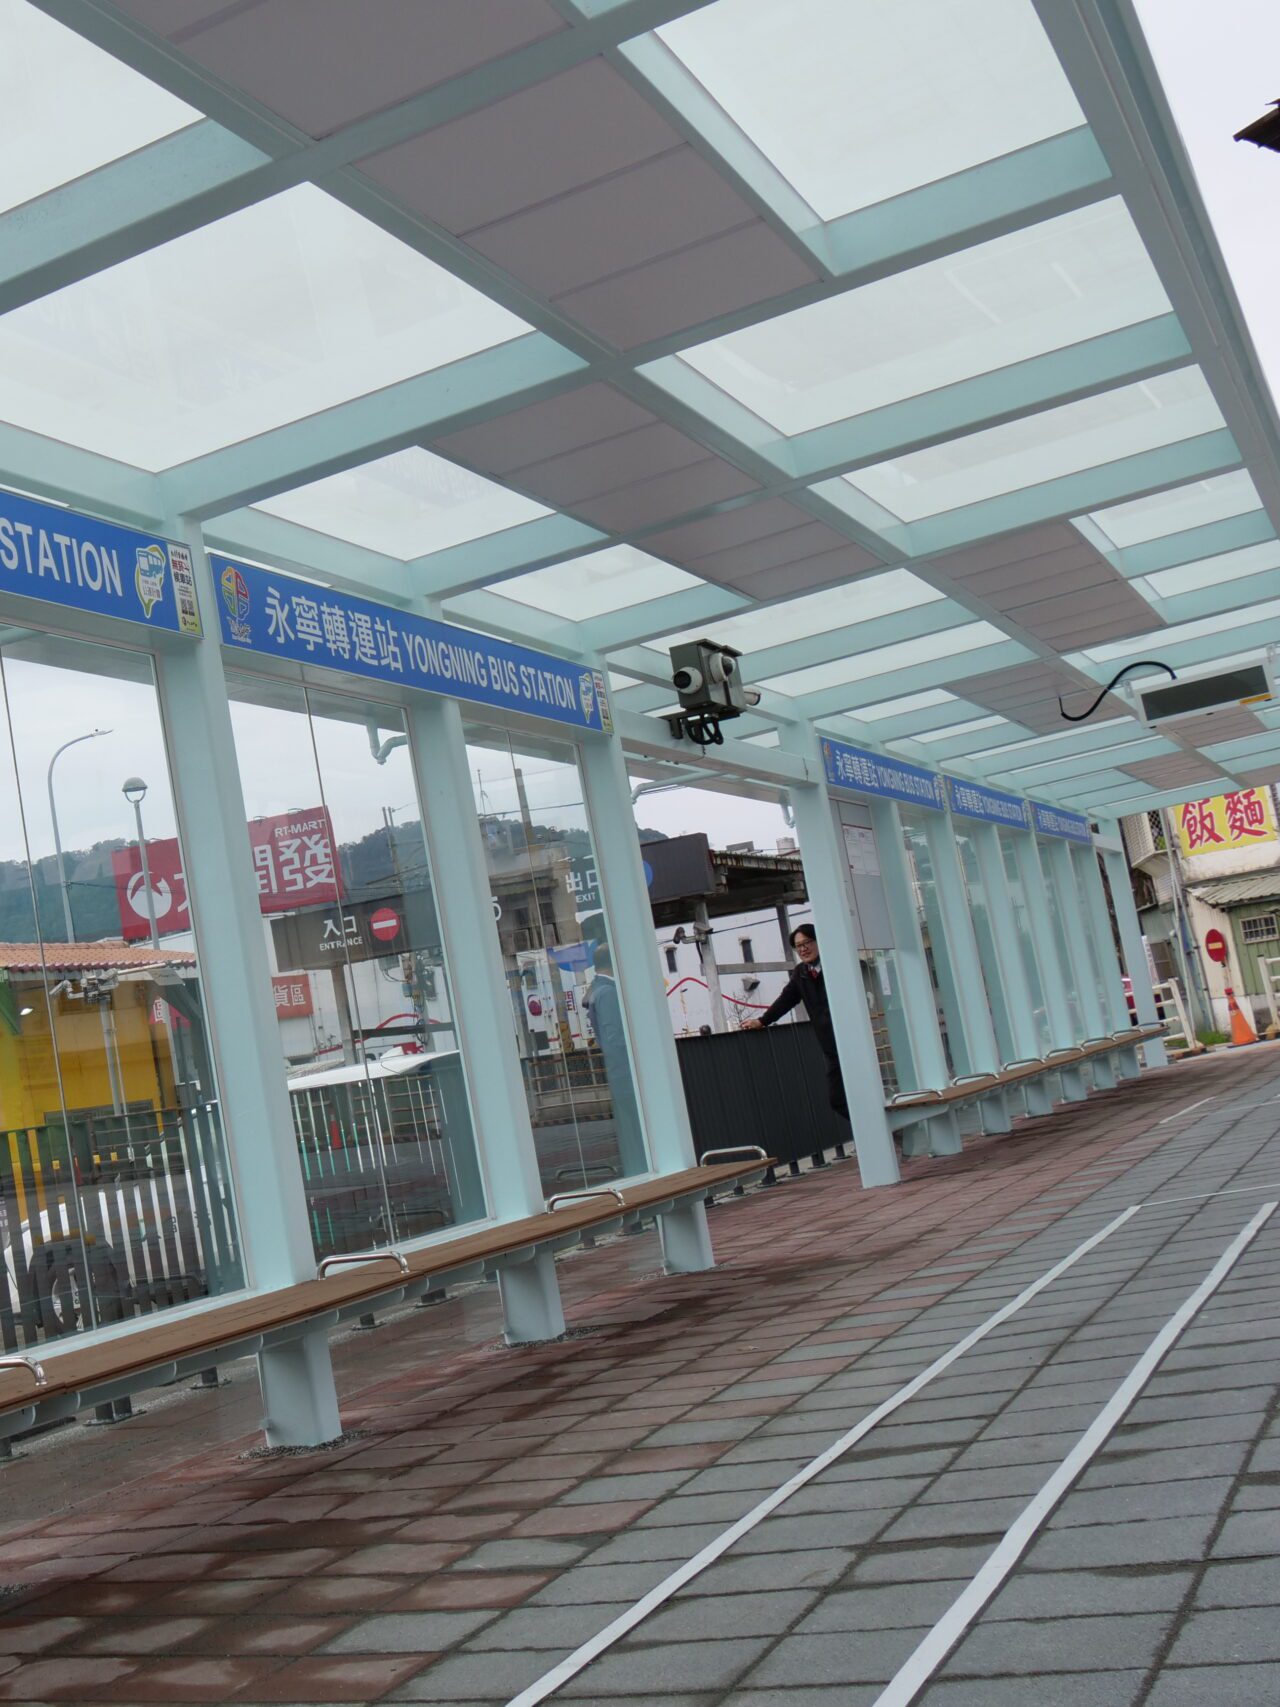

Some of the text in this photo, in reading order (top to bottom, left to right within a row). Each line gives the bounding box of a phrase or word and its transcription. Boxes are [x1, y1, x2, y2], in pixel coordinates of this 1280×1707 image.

[265, 586, 403, 672] 永寧轉運站
[402, 632, 489, 688] YONGNING
[488, 655, 520, 696] BUS
[520, 664, 577, 711] STATION
[274, 819, 326, 837] RT-MART
[565, 869, 599, 893] 出口
[575, 892, 596, 903] EXIT
[323, 915, 357, 938] 入口
